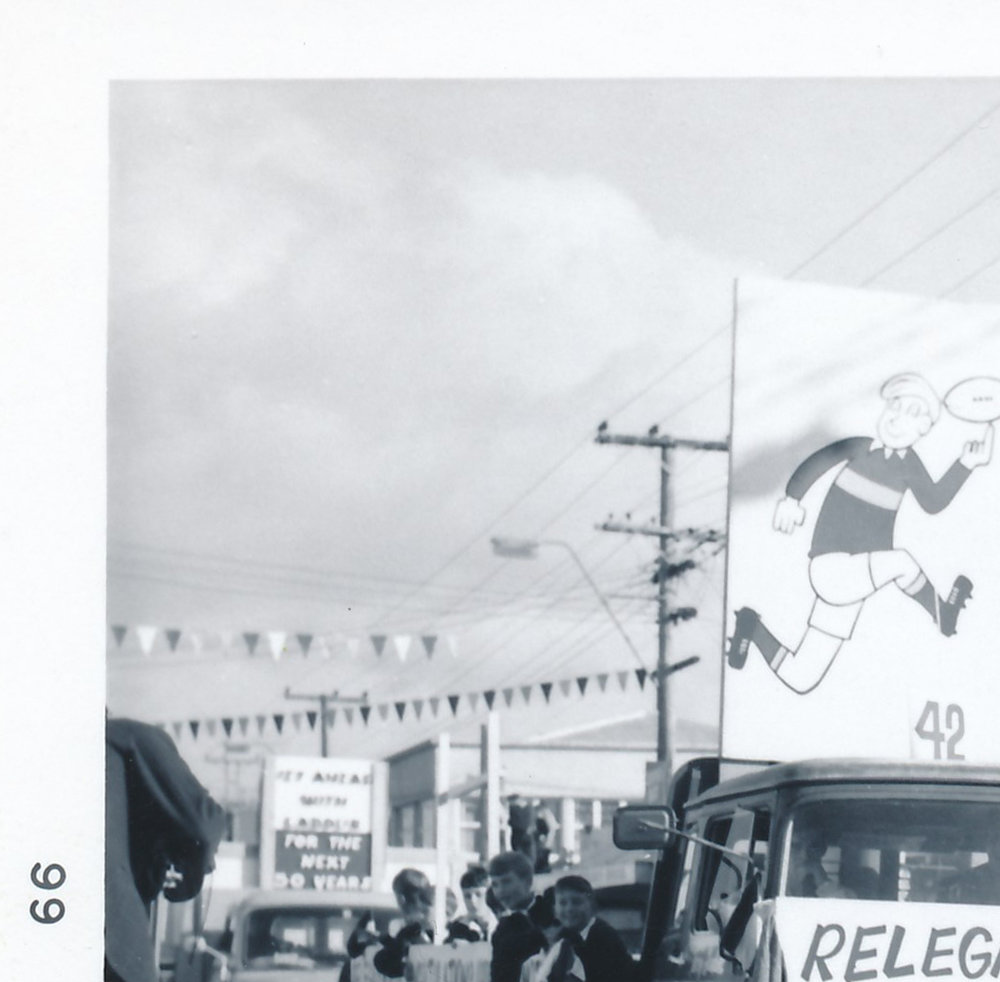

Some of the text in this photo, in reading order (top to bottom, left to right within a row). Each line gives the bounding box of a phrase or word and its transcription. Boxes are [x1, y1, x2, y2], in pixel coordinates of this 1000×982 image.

[914, 700, 966, 760] 42
[285, 834, 361, 851] FOR THE
[301, 855, 349, 869] NEXT
